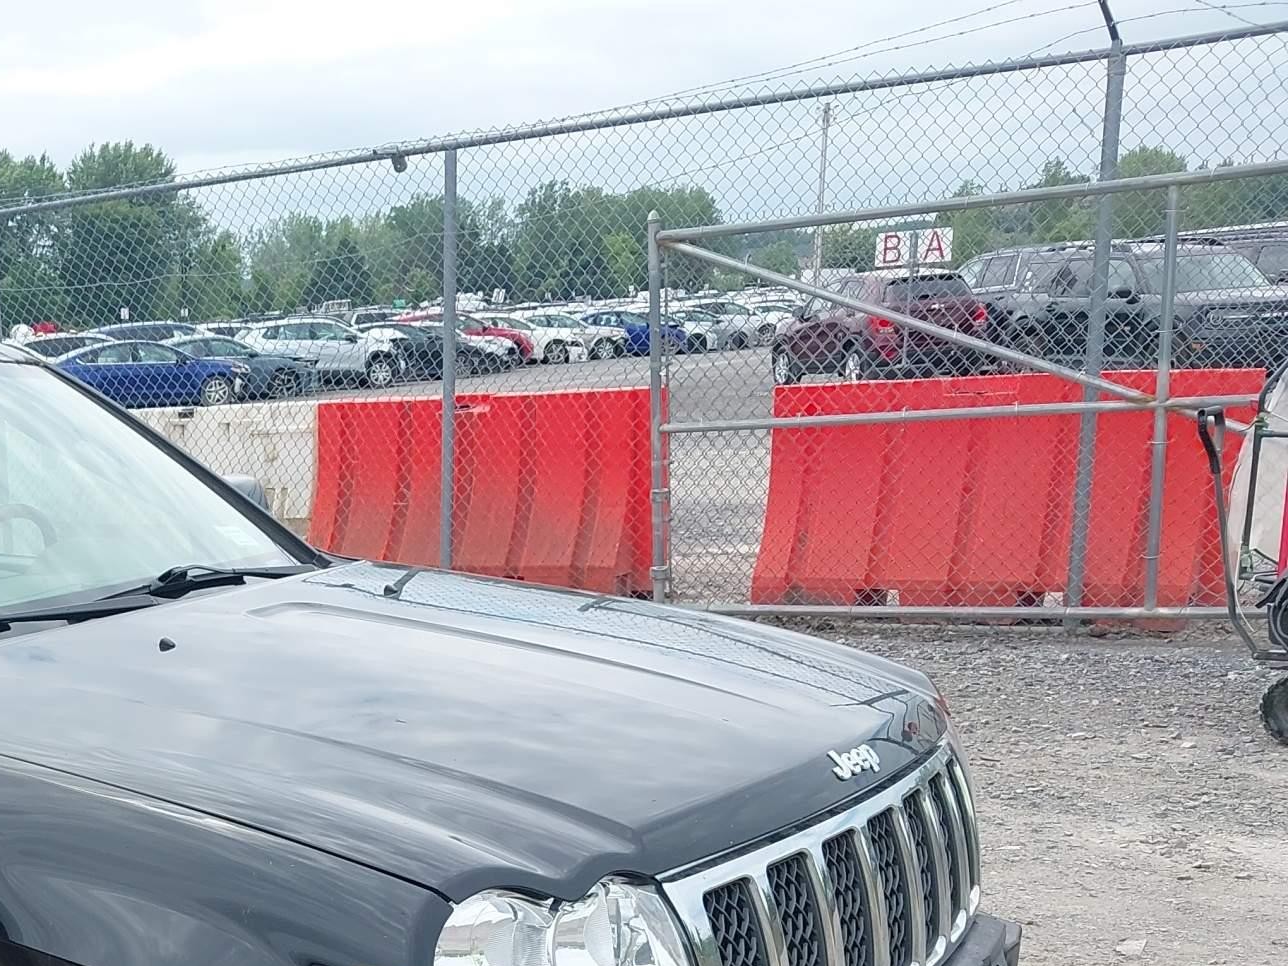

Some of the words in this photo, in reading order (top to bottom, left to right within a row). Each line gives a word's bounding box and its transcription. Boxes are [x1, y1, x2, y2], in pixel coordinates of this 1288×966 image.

[883, 234, 901, 263] B
[923, 231, 945, 260] A
[826, 744, 881, 780] Jeep
